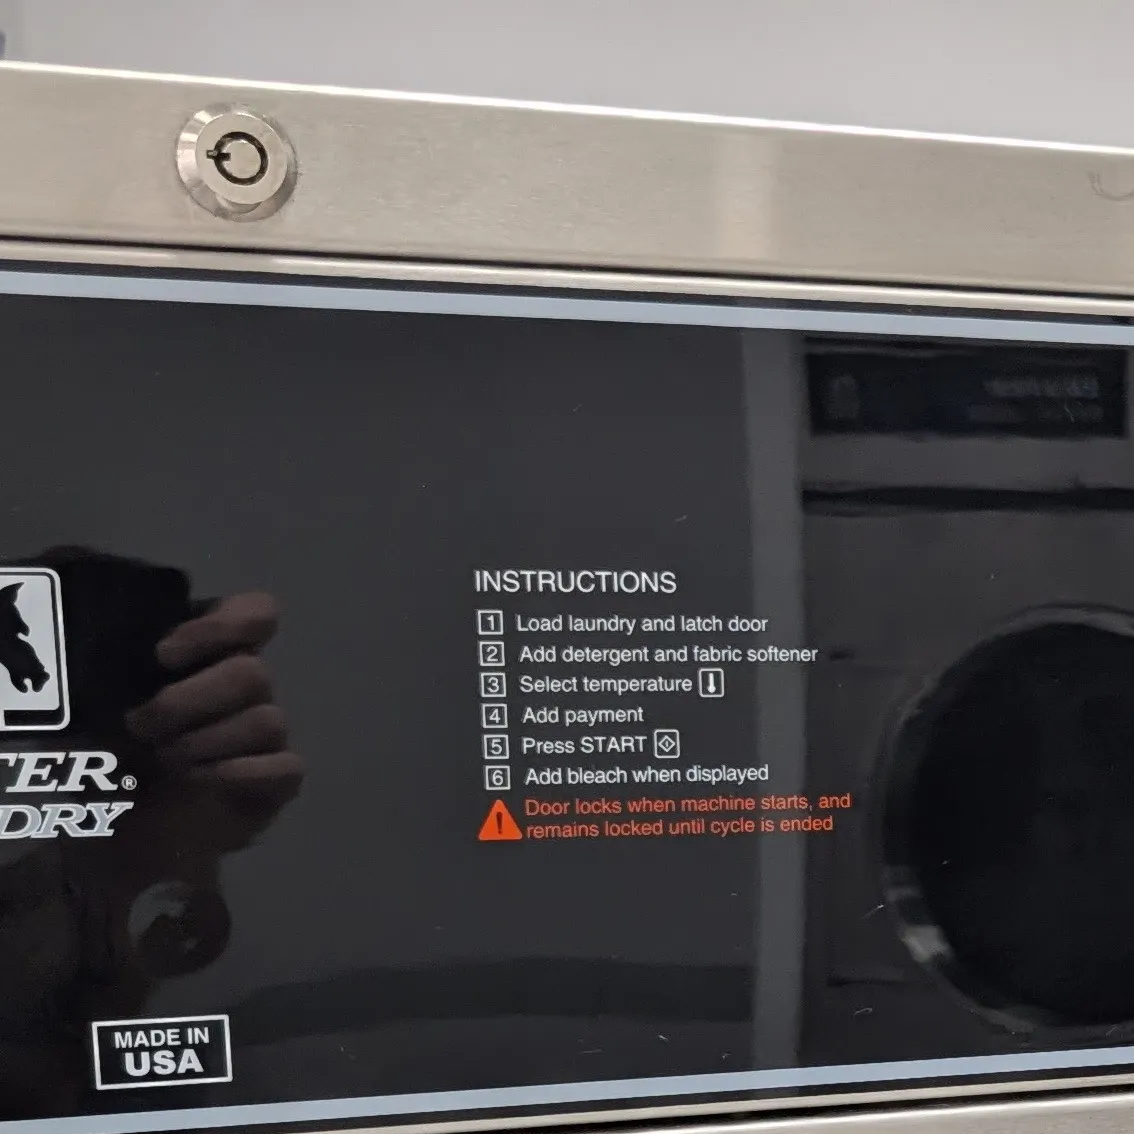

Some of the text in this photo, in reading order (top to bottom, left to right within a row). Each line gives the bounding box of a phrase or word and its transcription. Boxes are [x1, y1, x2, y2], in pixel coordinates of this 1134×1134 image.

[473, 570, 677, 594] INSTRUCTIONS
[486, 615, 768, 635] 1 Load laundry and latch door
[486, 646, 818, 666] 2 Add detergent and fabric softener
[487, 676, 693, 696] 3 Select temperature
[489, 706, 644, 727] 4 Add payment
[490, 736, 647, 754] 5 Press START
[492, 765, 769, 786] 6 Add bleach when displayed
[525, 793, 851, 817] Door locks when machine starts, and
[0, 801, 135, 840] DRY
[526, 816, 833, 839] remains locked until cycle is ended
[114, 1026, 210, 1049] MADE IN
[124, 1048, 204, 1077] USA
